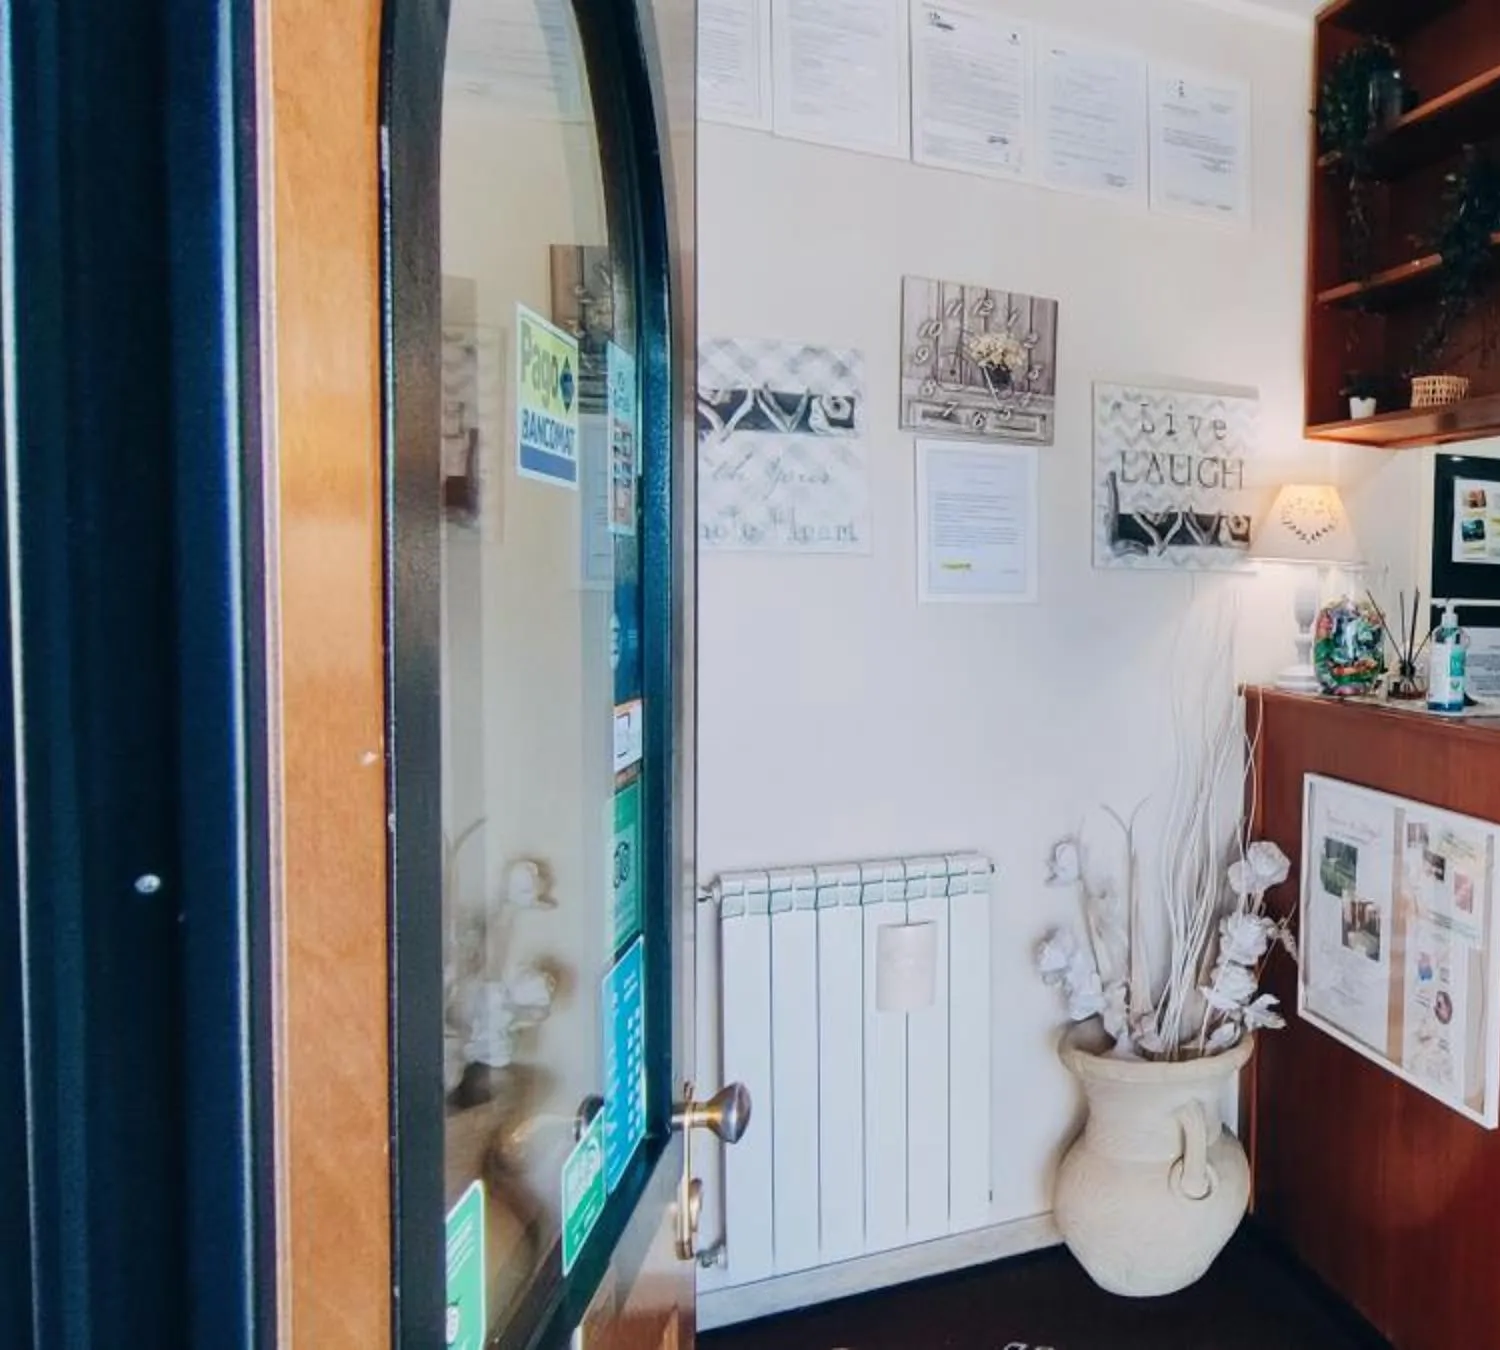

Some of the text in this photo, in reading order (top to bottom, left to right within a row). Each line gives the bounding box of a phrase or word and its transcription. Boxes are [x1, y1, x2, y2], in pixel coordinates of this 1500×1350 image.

[520, 318, 560, 408] Pago
[521, 407, 577, 457] BANCOMAT
[1119, 450, 1245, 490] LAUGH
